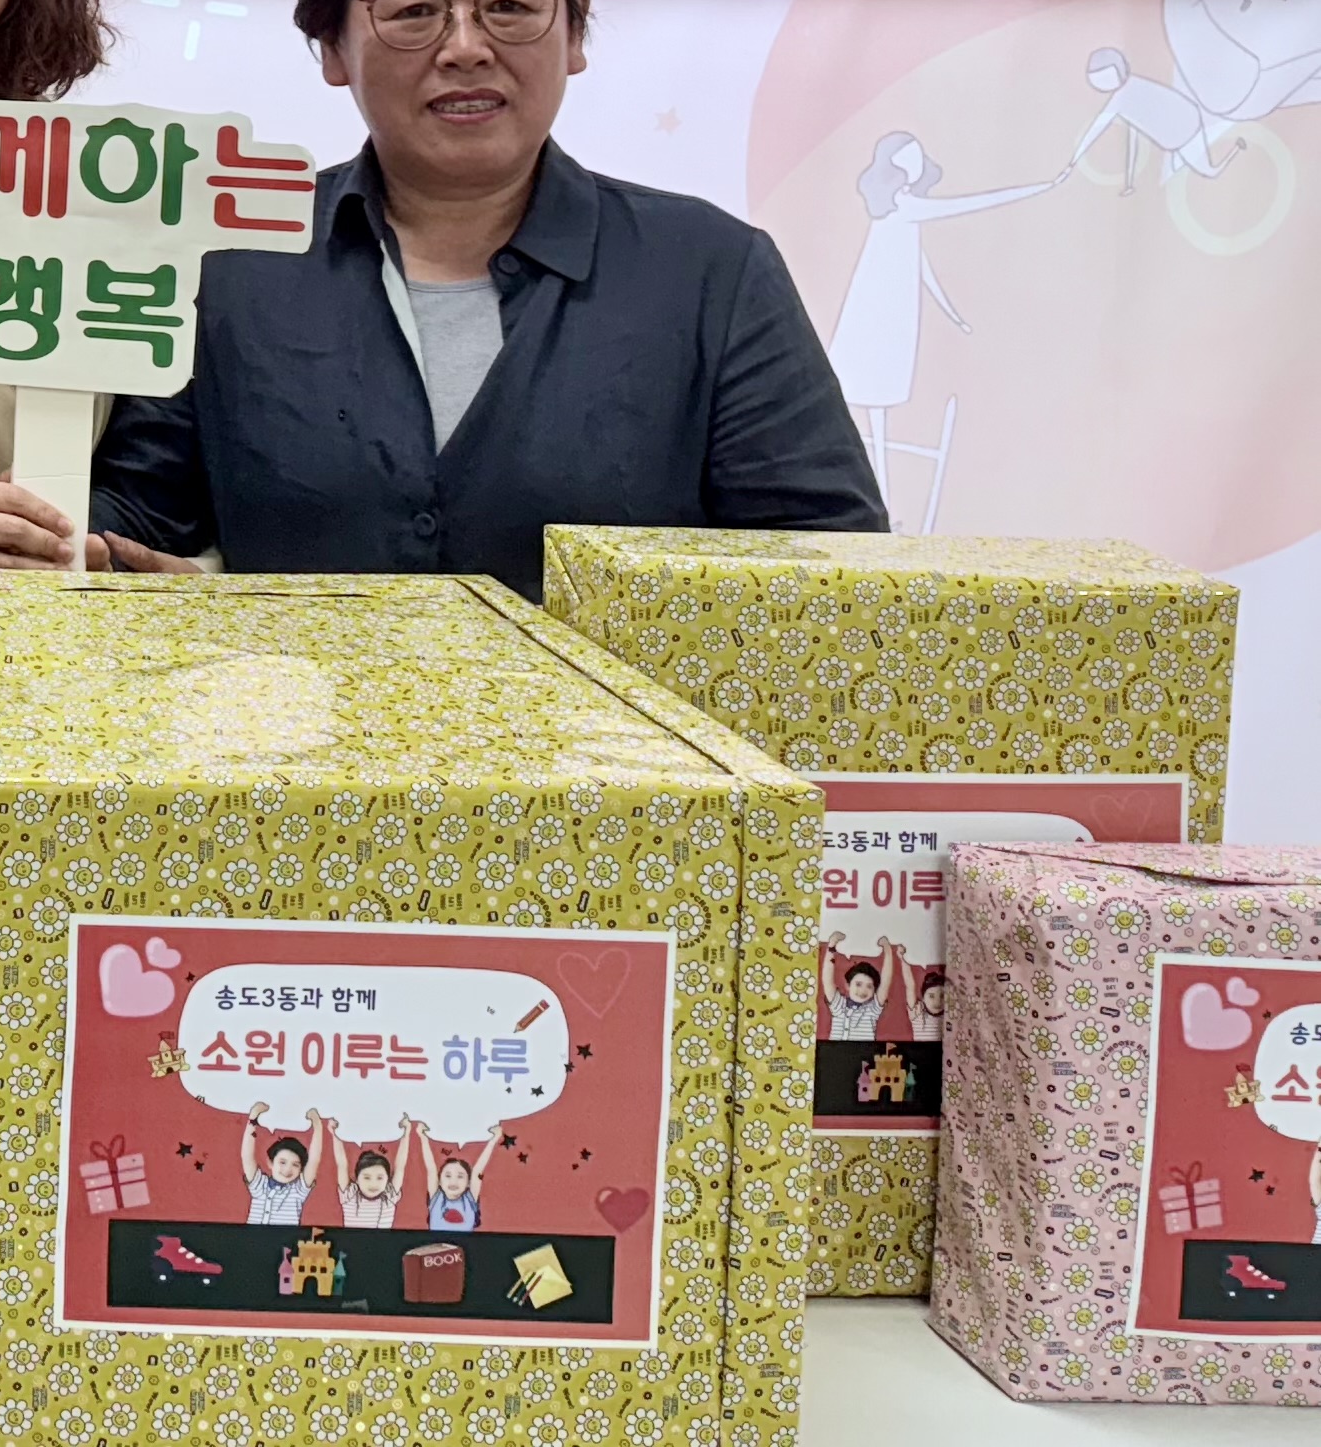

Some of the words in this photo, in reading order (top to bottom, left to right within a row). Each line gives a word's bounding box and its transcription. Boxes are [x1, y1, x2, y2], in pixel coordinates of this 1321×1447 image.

[898, 831, 937, 853] 함께
[822, 868, 859, 909] 원
[215, 986, 323, 1011] 송도3동과
[331, 987, 376, 1012] 함께
[197, 1030, 285, 1077] 소원
[301, 1031, 429, 1080] 이루는
[442, 1034, 530, 1086] 하루
[1272, 1064, 1321, 1106] 소
[423, 1253, 463, 1267] BOOK
